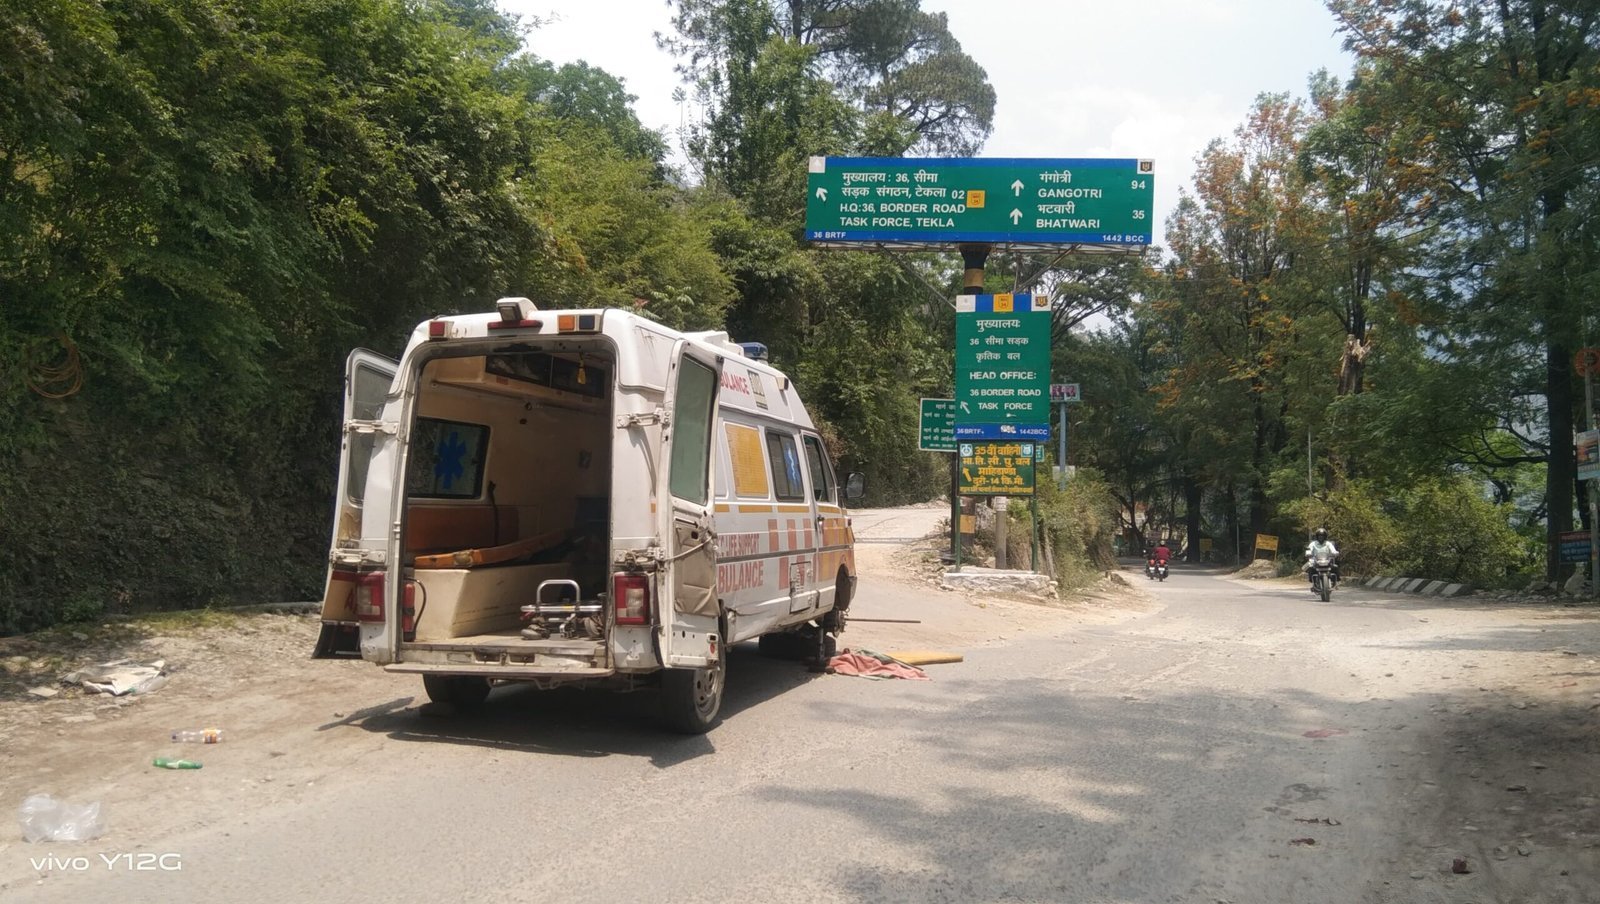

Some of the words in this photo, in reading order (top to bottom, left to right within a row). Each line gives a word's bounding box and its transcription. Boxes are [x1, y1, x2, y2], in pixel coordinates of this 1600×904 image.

[913, 169, 938, 183] सीमा
[1039, 170, 1072, 184] गंगोत्री
[1131, 180, 1146, 190] 94
[841, 186, 870, 199] सड़क
[915, 184, 946, 198] टेकला
[951, 190, 965, 200] 02
[1038, 188, 1102, 198] GANGOTRI
[880, 203, 927, 213] BORDER
[932, 203, 966, 213] ROAD
[1037, 201, 1075, 214] भटवारी
[1132, 210, 1145, 220] 35
[840, 217, 868, 227] TASK
[872, 217, 913, 228] FORCE,
[916, 217, 954, 227] TEKLA
[1036, 218, 1100, 229] BHATWARI
[824, 231, 847, 239] BRTF
[969, 338, 979, 346] 36
[985, 335, 1004, 345] सीमा
[969, 371, 997, 380] HEAD
[1000, 371, 1037, 380] OFFICE:
[978, 402, 999, 410] TASK
[1004, 402, 1033, 410] FORCE
[974, 446, 986, 455] 35
